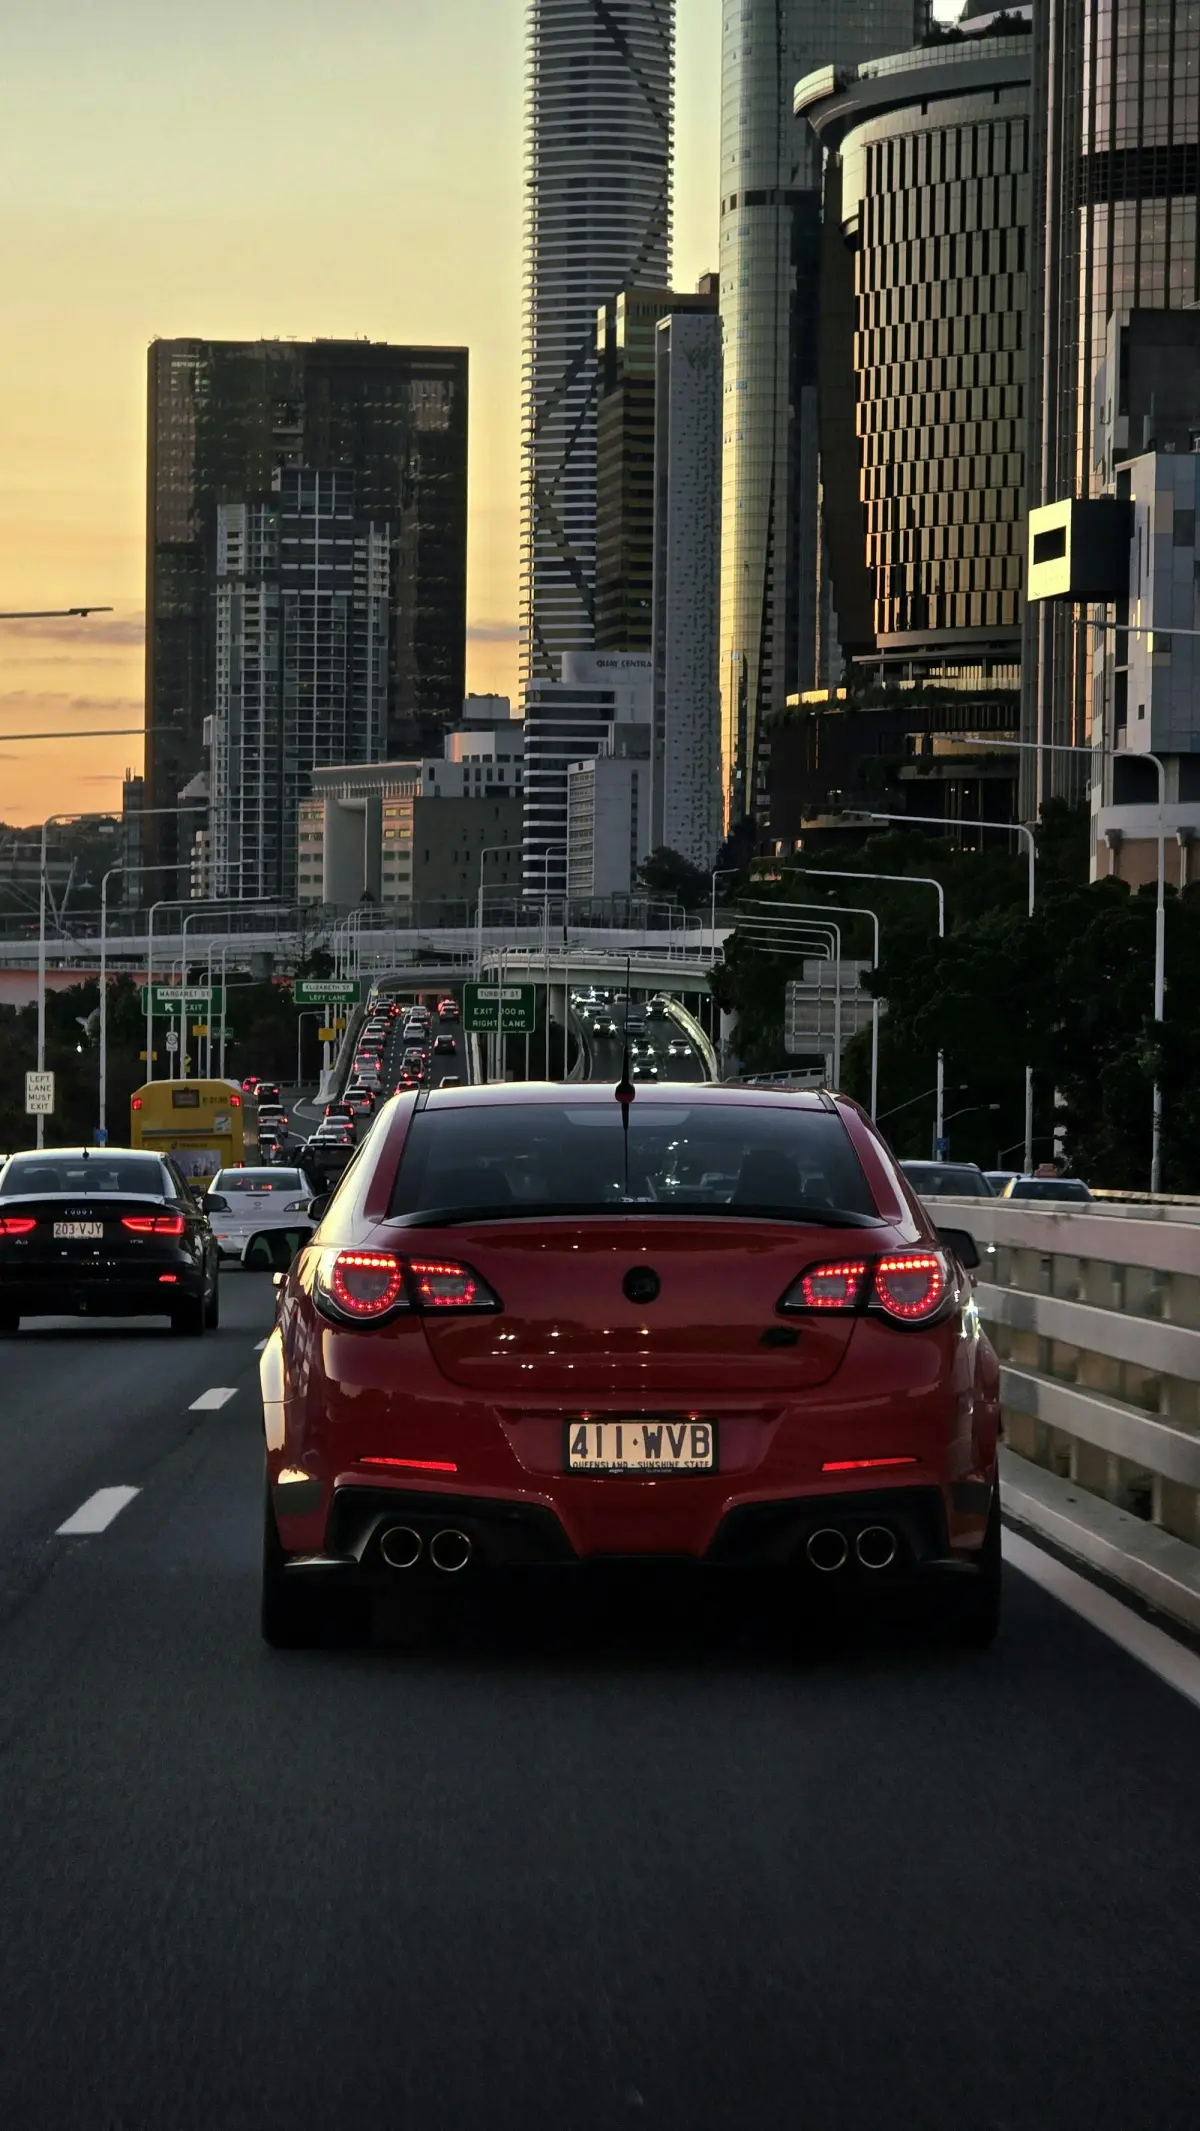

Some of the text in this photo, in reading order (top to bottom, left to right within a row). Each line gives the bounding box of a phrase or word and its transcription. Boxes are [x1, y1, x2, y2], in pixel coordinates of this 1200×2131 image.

[596, 660, 652, 668] QUAY CENTRA
[29, 1075, 50, 1083] LEFT
[29, 1084, 52, 1092] LANE
